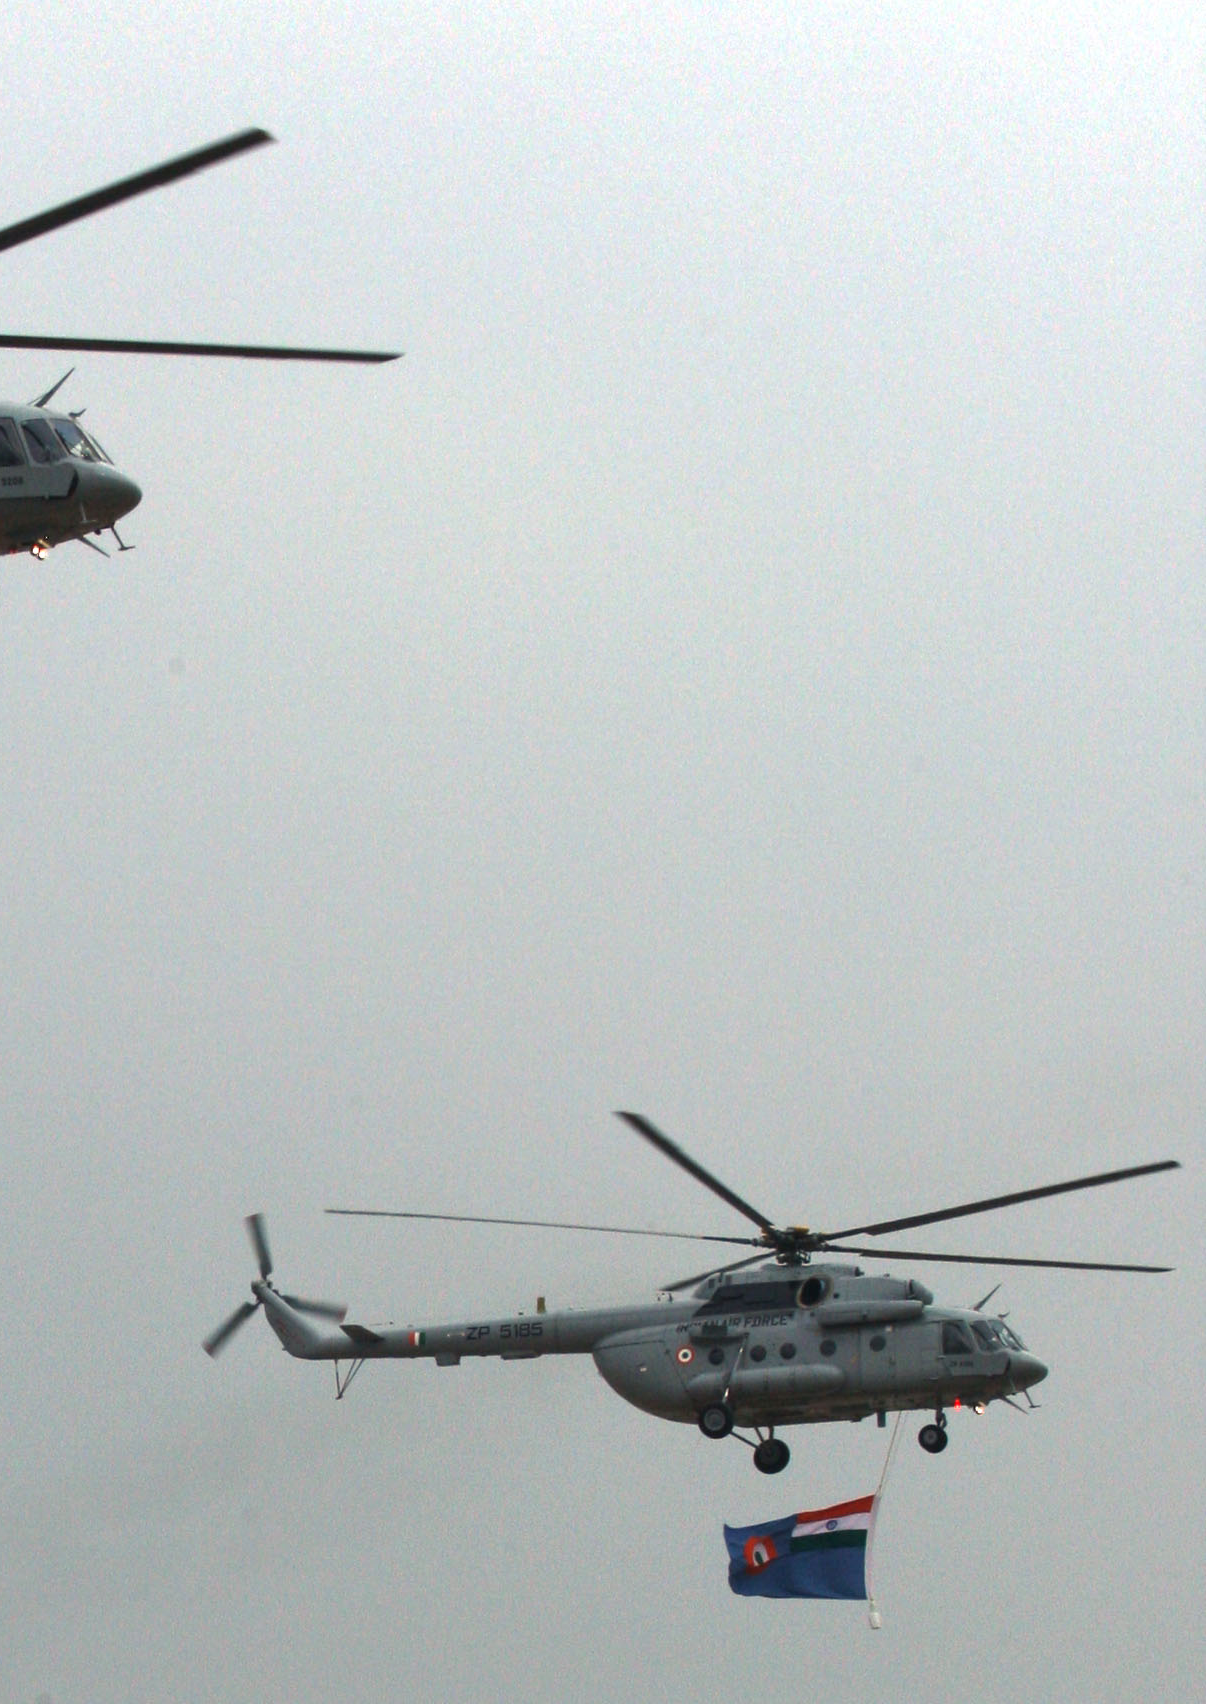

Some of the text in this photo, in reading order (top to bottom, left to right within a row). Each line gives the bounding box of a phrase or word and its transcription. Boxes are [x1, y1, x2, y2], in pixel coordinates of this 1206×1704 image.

[743, 1314, 787, 1329] FORCE
[466, 1322, 544, 1341] ZP 5185
